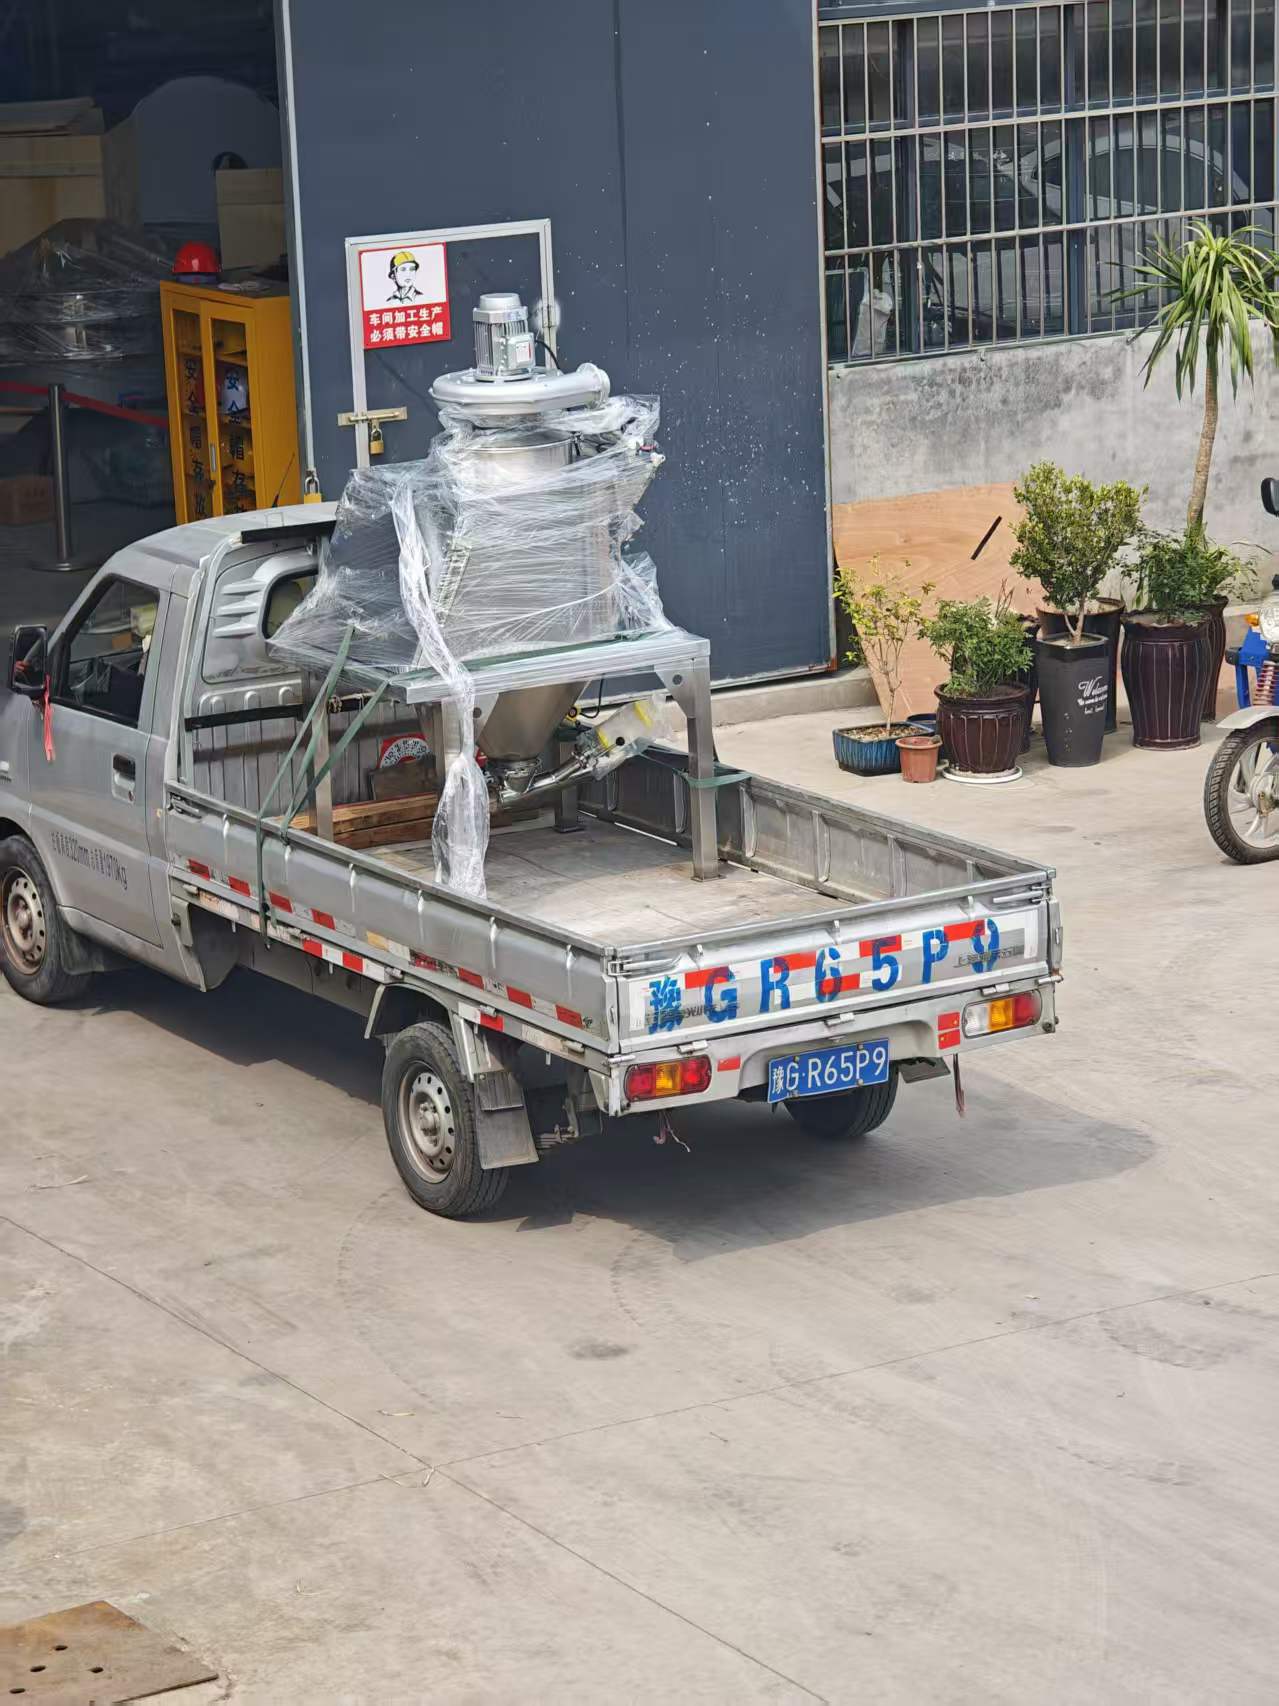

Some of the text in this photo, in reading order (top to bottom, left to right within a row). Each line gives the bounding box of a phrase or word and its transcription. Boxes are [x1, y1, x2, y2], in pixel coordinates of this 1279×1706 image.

[369, 306, 443, 326] 车间加工生产
[370, 322, 444, 343] 必须带安全帽
